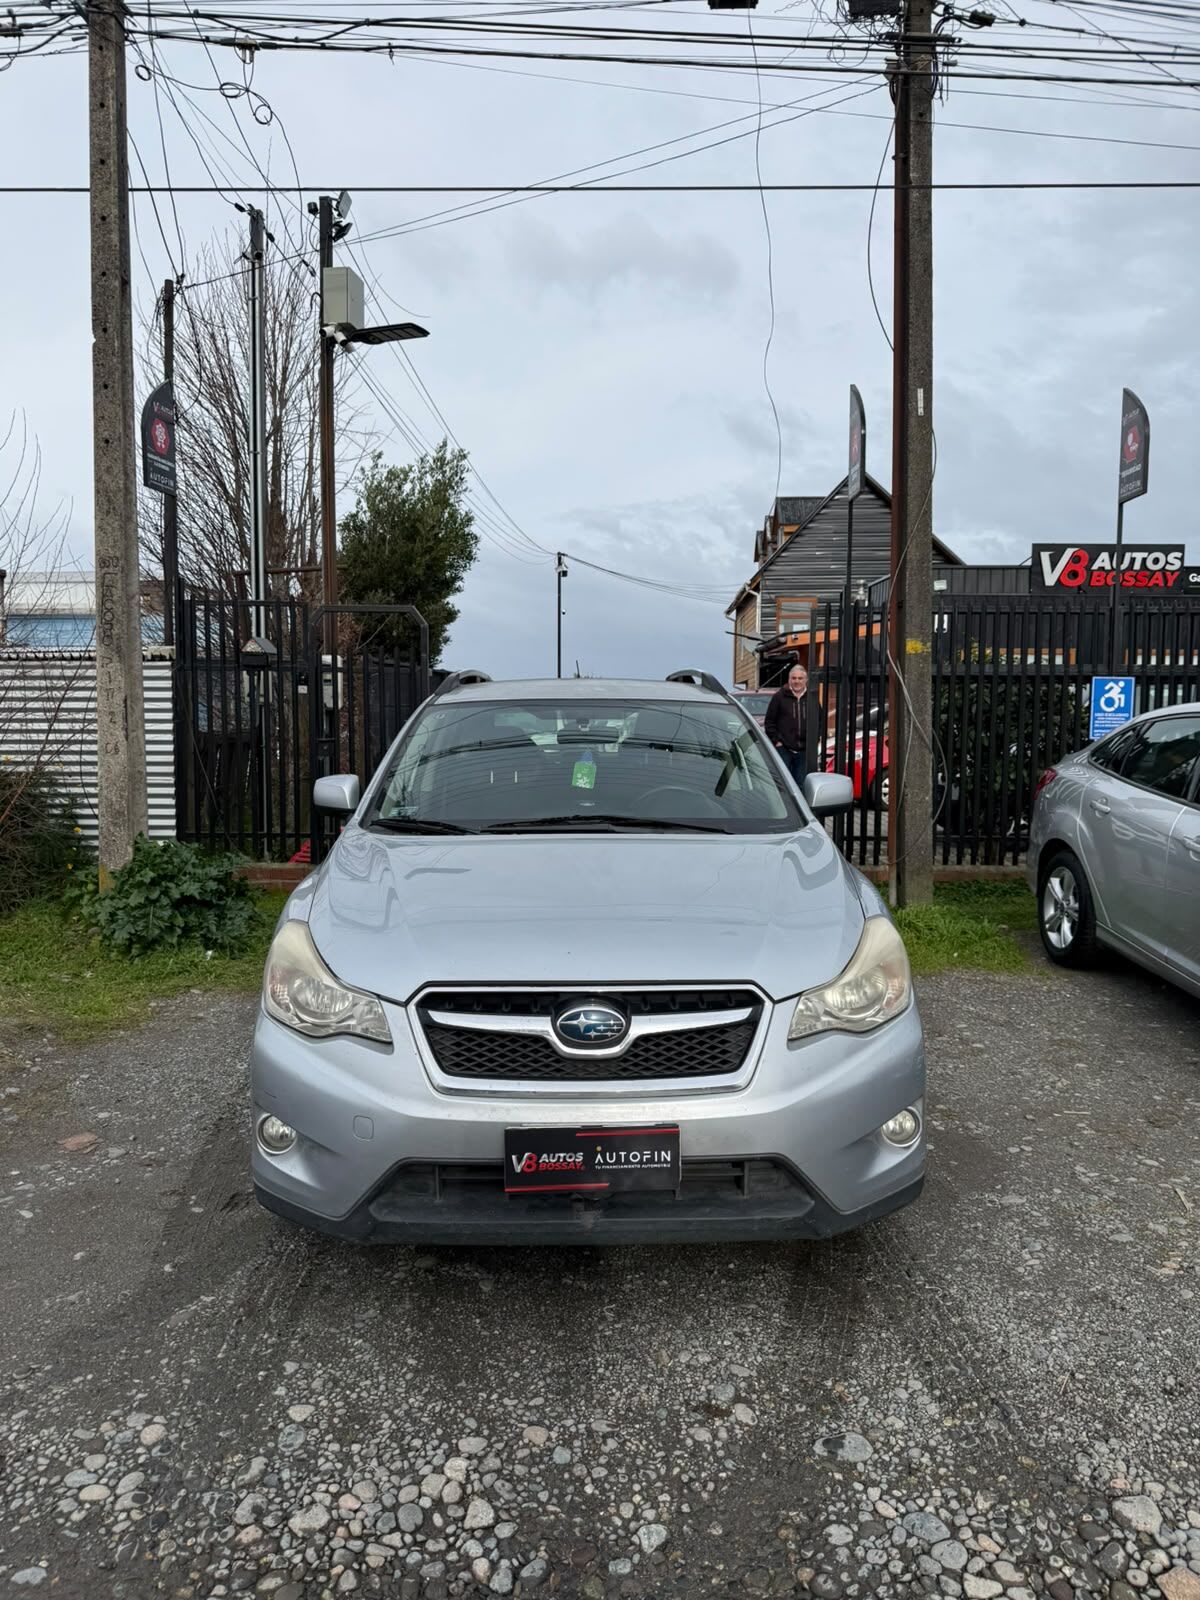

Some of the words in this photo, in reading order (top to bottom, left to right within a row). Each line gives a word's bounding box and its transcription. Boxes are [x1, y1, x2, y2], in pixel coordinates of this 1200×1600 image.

[1040, 547, 1089, 587] V8
[1091, 551, 1183, 570] AUTOS
[511, 1152, 538, 1173] V8
[539, 1152, 584, 1163] AUTOS
[594, 1149, 671, 1164] AUTOFIN
[538, 1162, 583, 1171] BOSSAY
